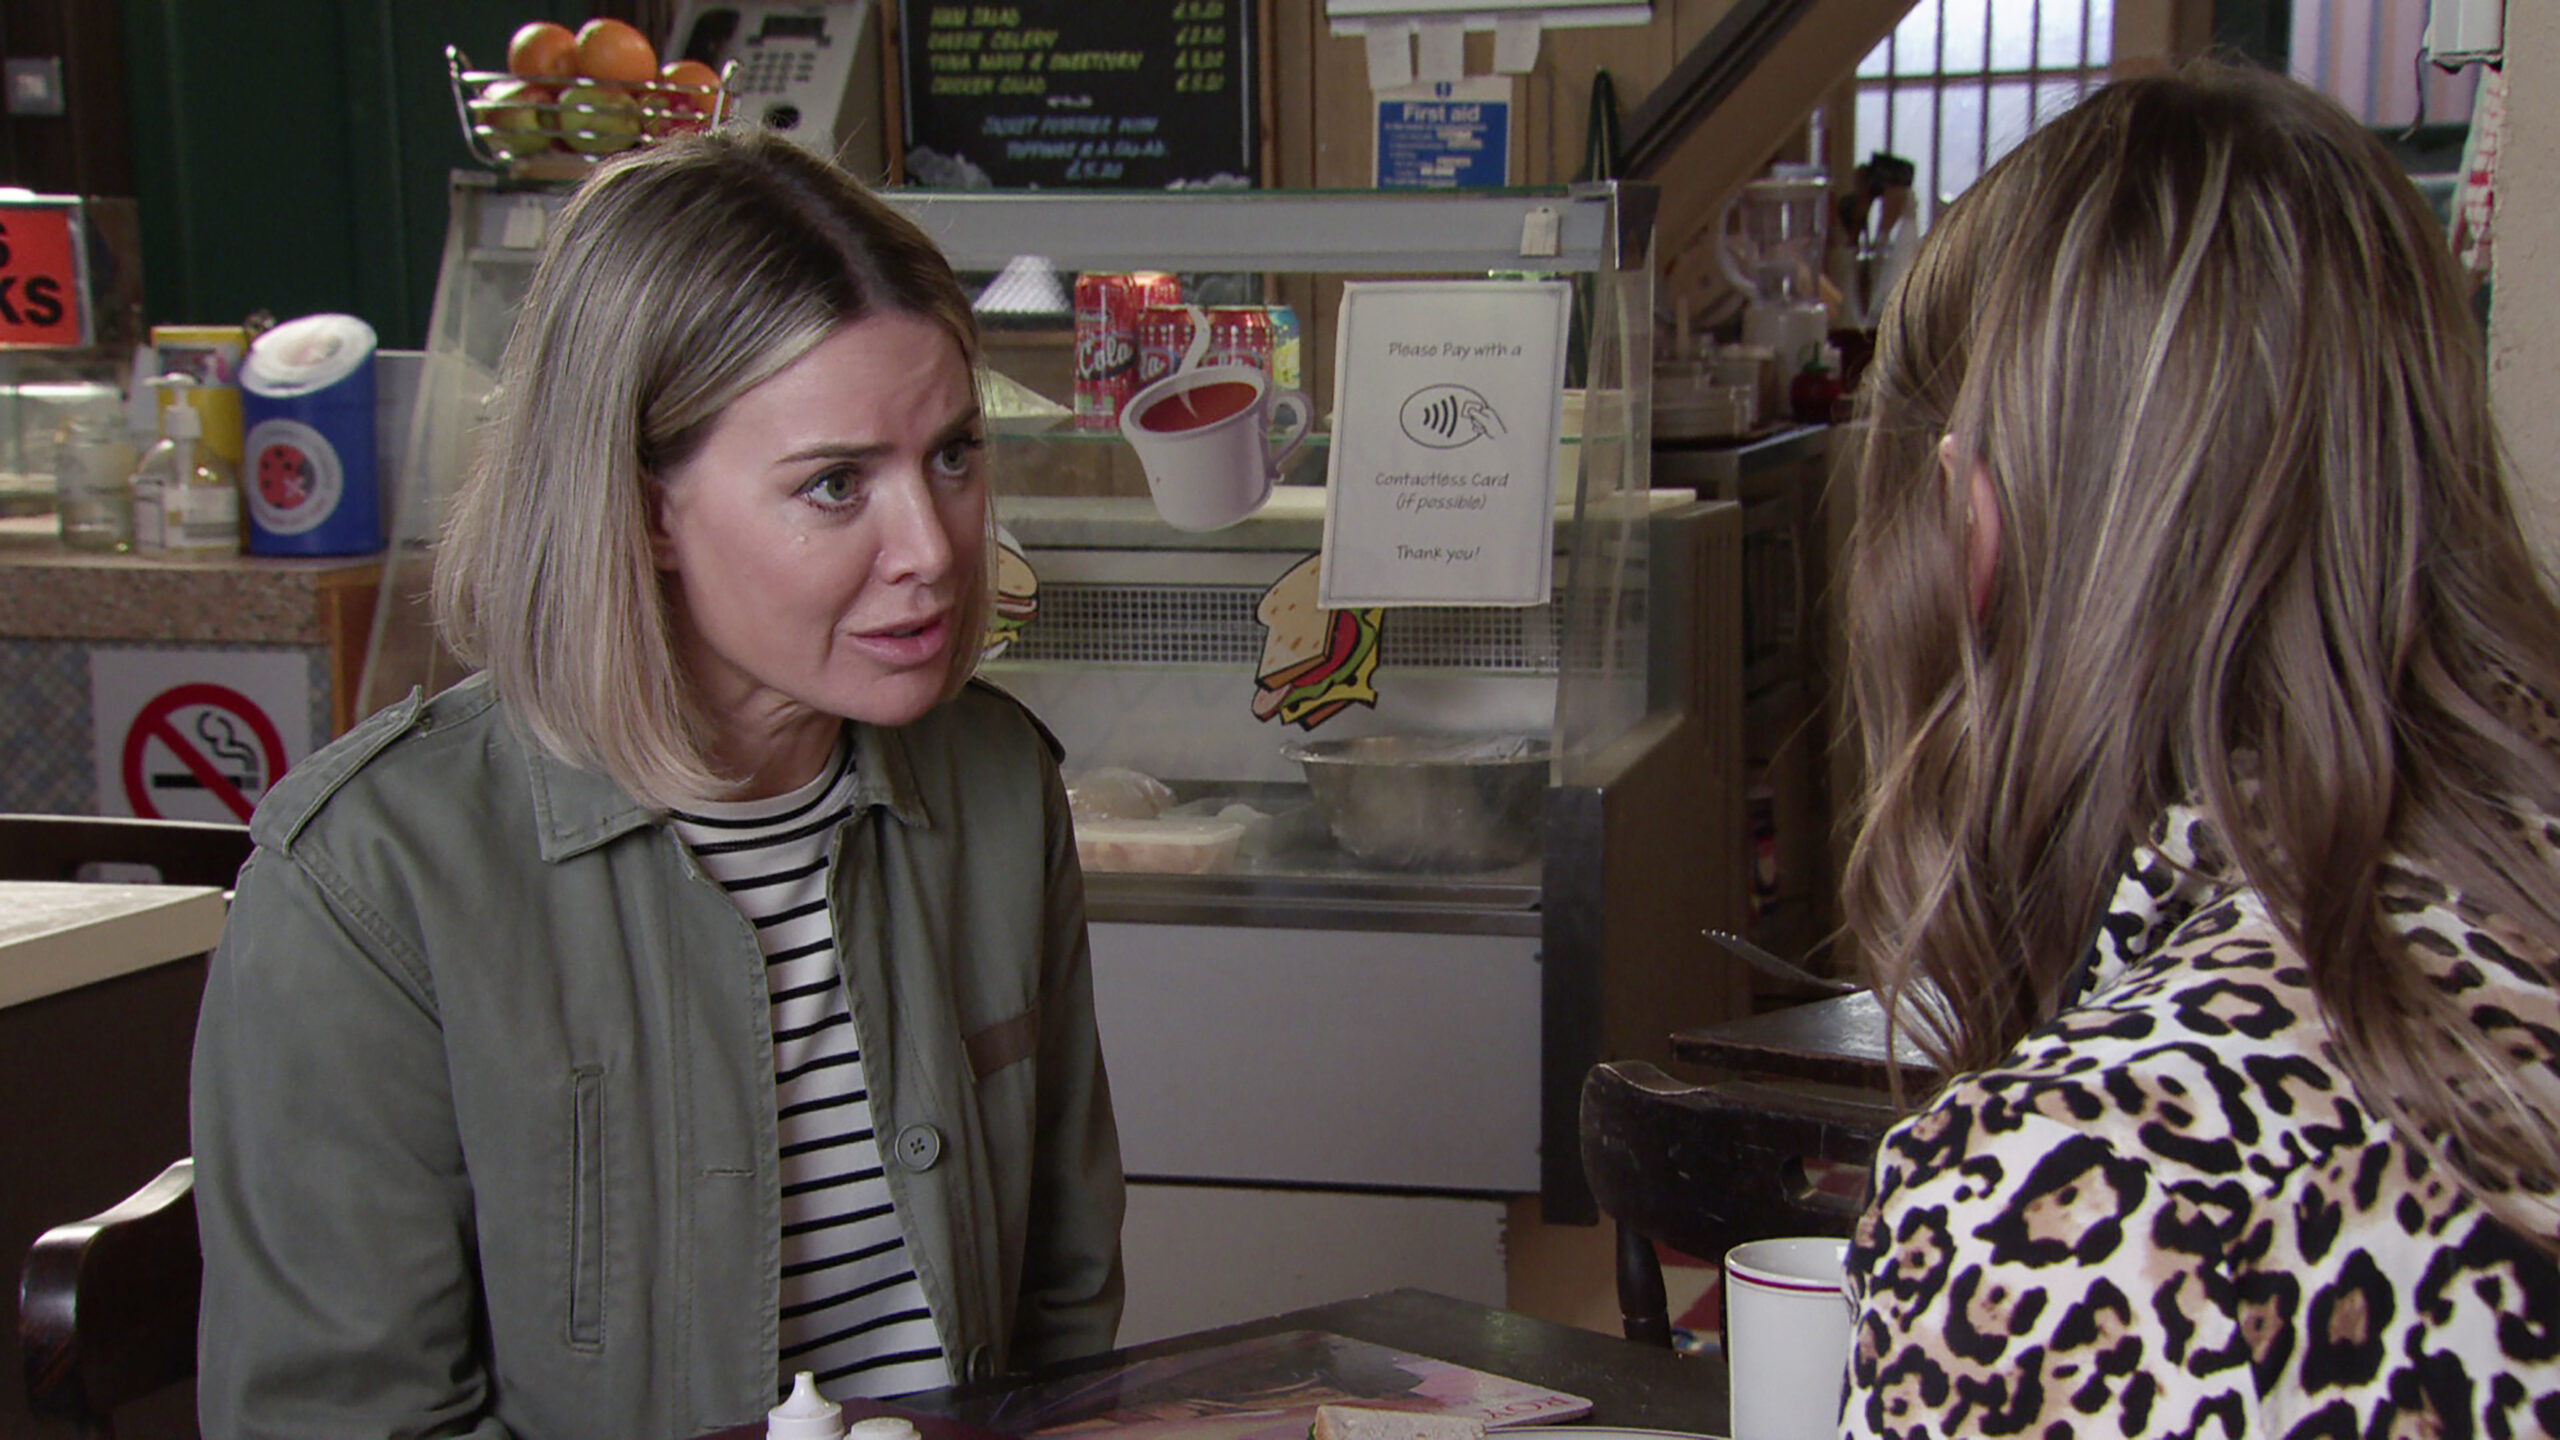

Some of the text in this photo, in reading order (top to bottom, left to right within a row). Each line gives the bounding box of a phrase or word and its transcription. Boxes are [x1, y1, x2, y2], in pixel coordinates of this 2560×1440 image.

[1403, 103, 1481, 122] First aid
[1080, 336, 1132, 379] Cola
[1389, 342, 1522, 361] Please Pay with a
[1375, 472, 1509, 487] Contactless Card
[1415, 493, 1487, 515] possible)
[1397, 545, 1480, 565] Thank you!
